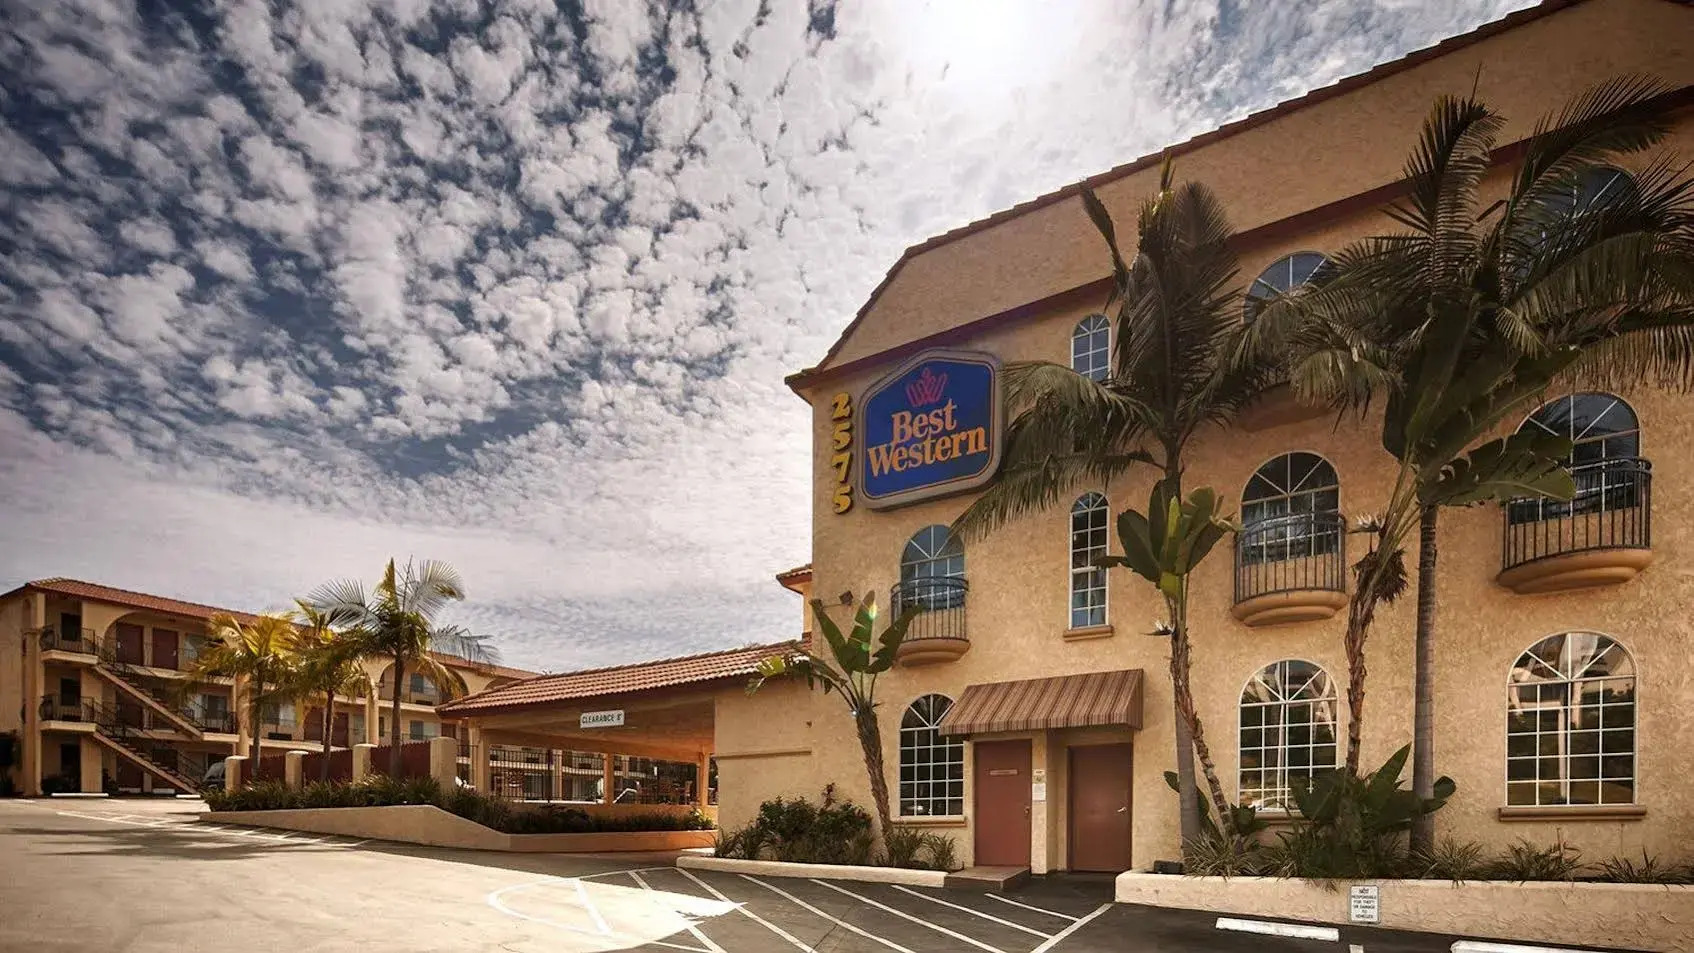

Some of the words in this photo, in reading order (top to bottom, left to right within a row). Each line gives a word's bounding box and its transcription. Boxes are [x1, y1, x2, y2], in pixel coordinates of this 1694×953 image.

[891, 398, 957, 444] Best
[832, 392, 851, 514] 2575
[867, 426, 987, 478] Western
[582, 714, 614, 724] CLEARANCE
